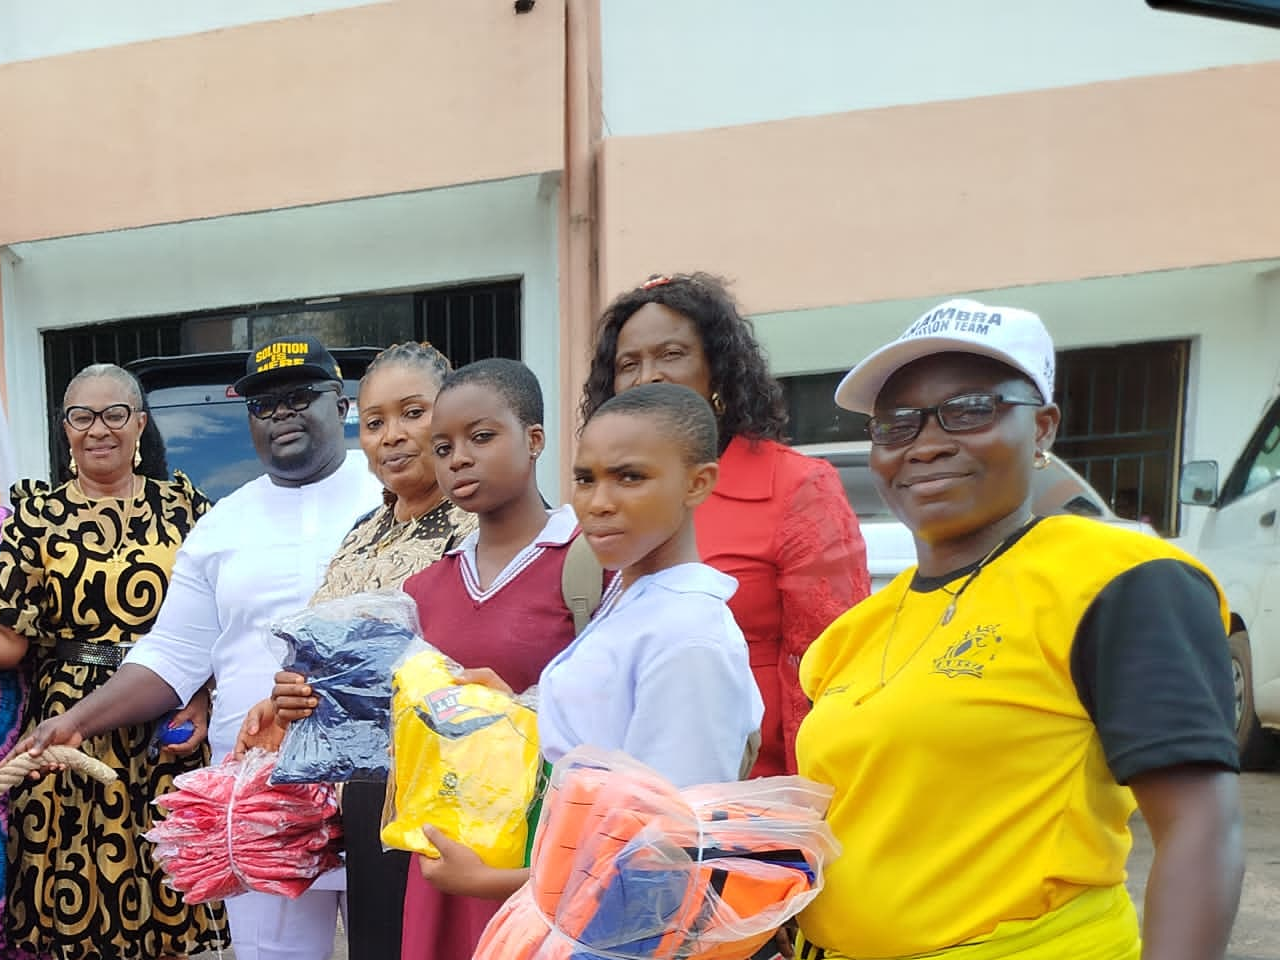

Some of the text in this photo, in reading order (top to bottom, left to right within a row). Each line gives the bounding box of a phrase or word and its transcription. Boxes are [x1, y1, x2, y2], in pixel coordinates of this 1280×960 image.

[954, 322, 990, 335] TEAM
[255, 342, 308, 363] SOLUTION
[271, 352, 287, 361] IS
[257, 358, 304, 373] HERE
